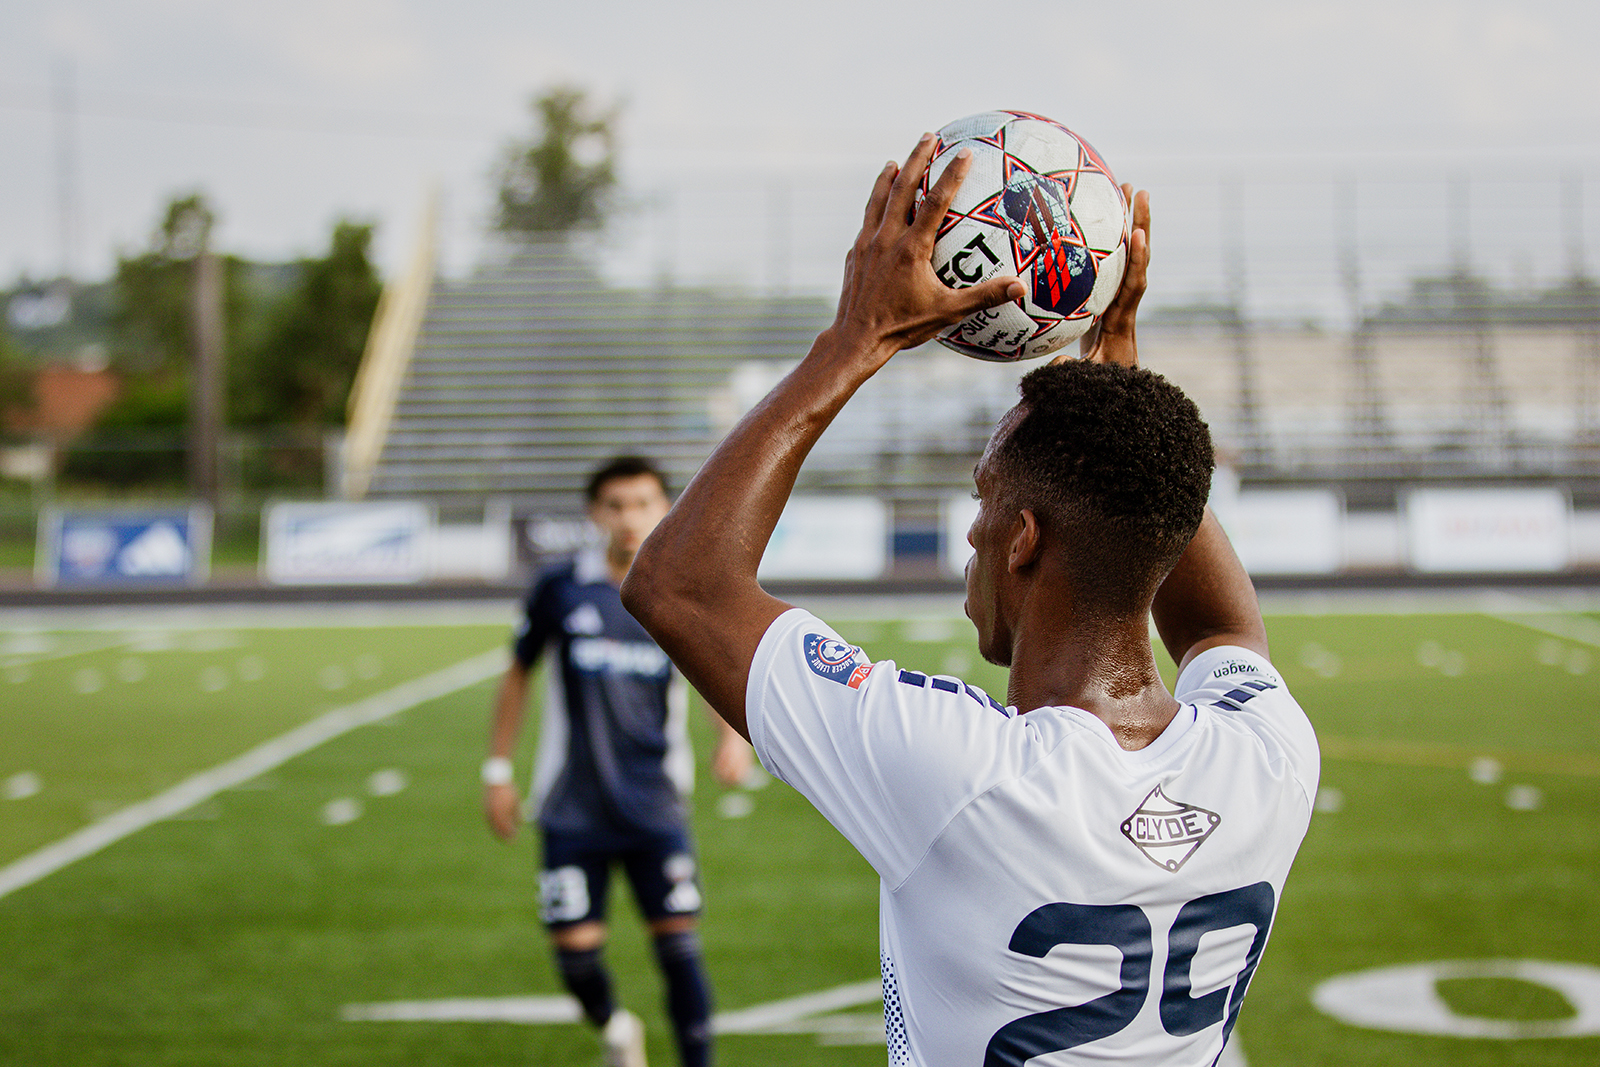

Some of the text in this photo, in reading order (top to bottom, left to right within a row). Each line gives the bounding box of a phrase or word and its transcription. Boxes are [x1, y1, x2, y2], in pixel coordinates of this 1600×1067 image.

[961, 309, 999, 335] SUFC
[811, 657, 853, 673] SOCCER LEAGUE
[1136, 812, 1204, 841] CLYDE
[983, 880, 1276, 1067] 29
